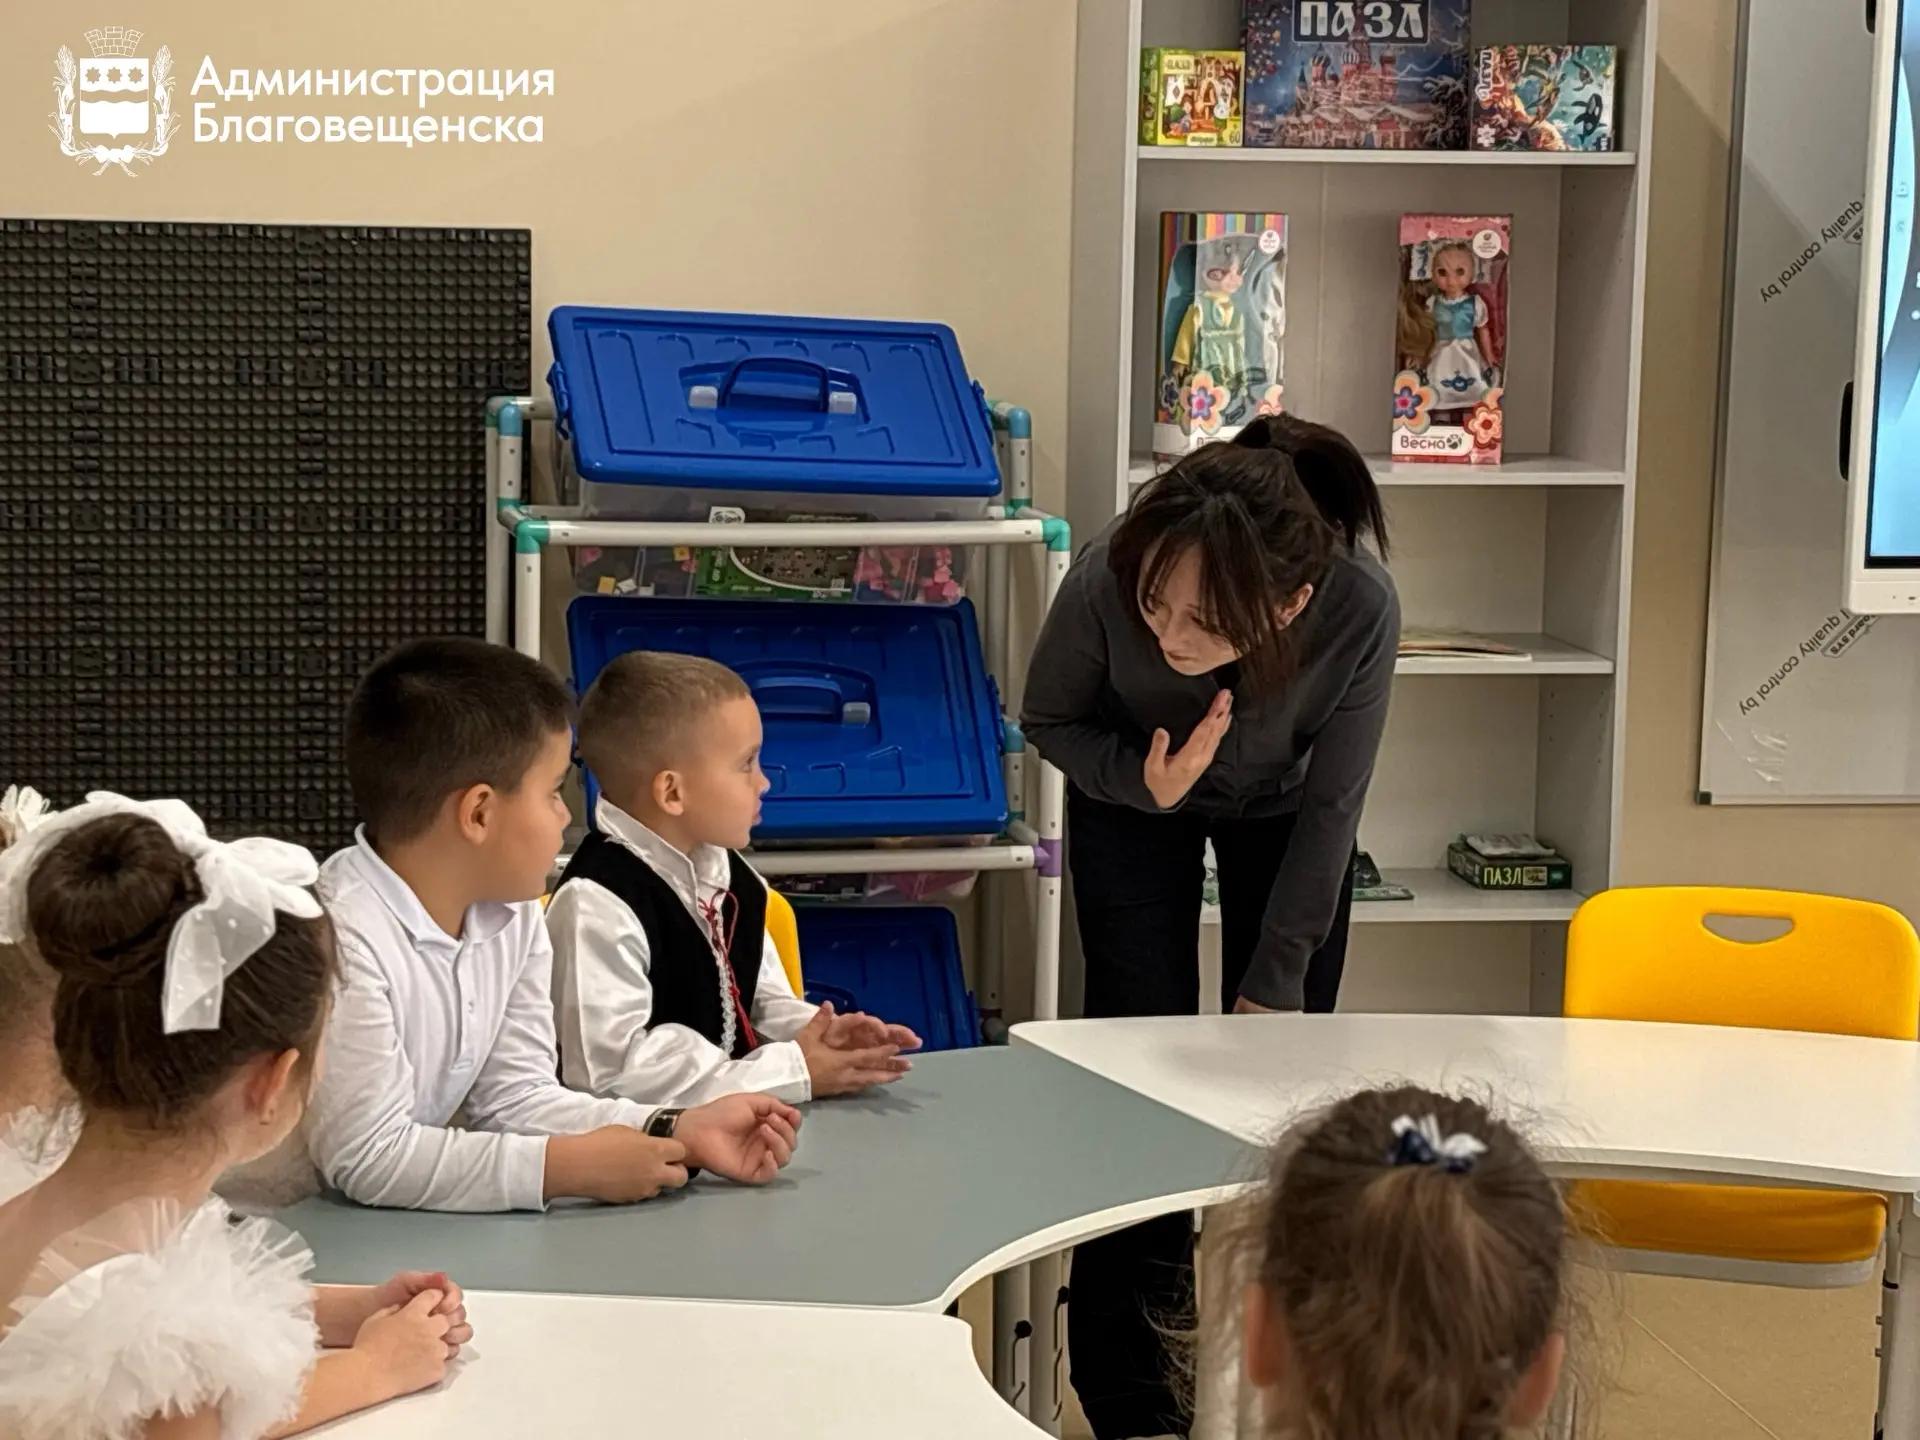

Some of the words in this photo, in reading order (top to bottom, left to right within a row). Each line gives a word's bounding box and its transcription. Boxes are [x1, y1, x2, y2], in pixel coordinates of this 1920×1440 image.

[1300, 1, 1424, 38] ПАЗЛ
[1478, 50, 1493, 92] ПАЗЛ
[1820, 200, 1863, 244] quality
[1778, 241, 1821, 288] control
[1760, 283, 1781, 303] by
[1400, 435, 1446, 449] Весна
[1799, 615, 1841, 657] quality
[1848, 613, 1876, 638] oard
[1756, 655, 1800, 701] control
[1739, 696, 1760, 716] by
[1484, 866, 1521, 885] ПАЗЛ
